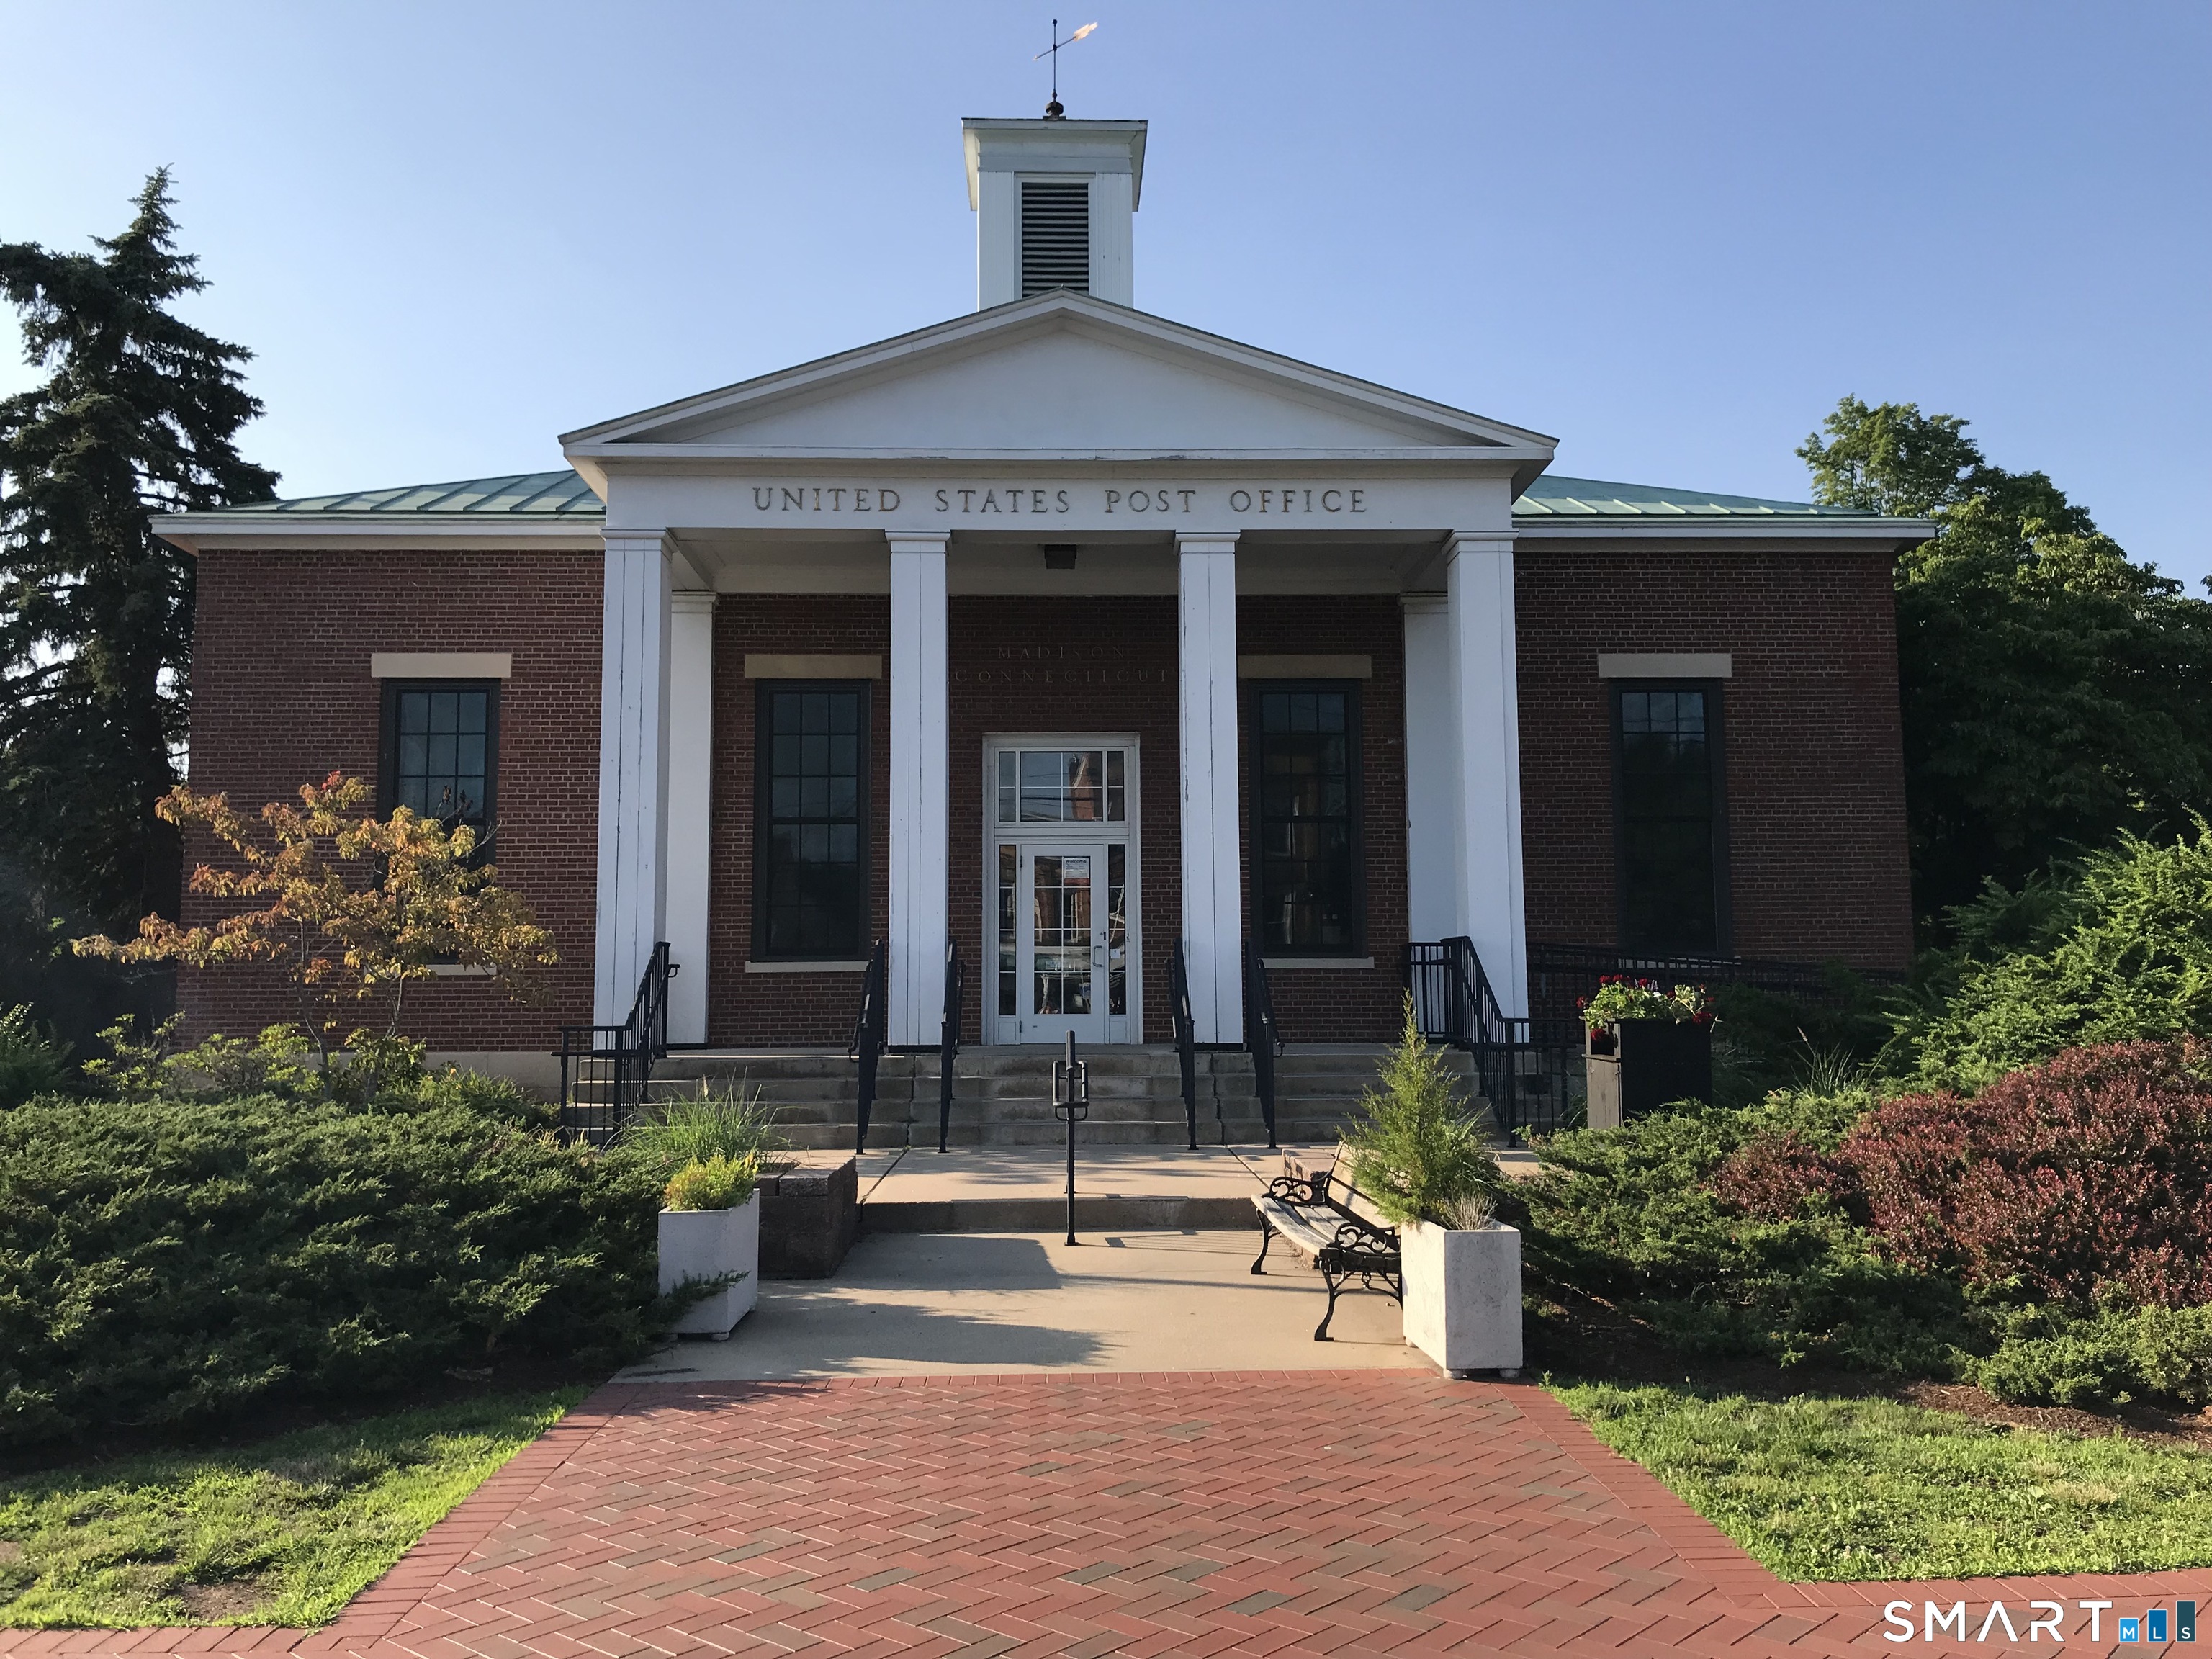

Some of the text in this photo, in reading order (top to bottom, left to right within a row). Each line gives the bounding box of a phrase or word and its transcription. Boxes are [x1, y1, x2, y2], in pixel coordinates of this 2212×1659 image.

[753, 487, 1367, 513] UNITED STATES POST OFFICE
[998, 646, 1125, 660] MADISON
[955, 669, 1167, 683] CONNECTICUT
